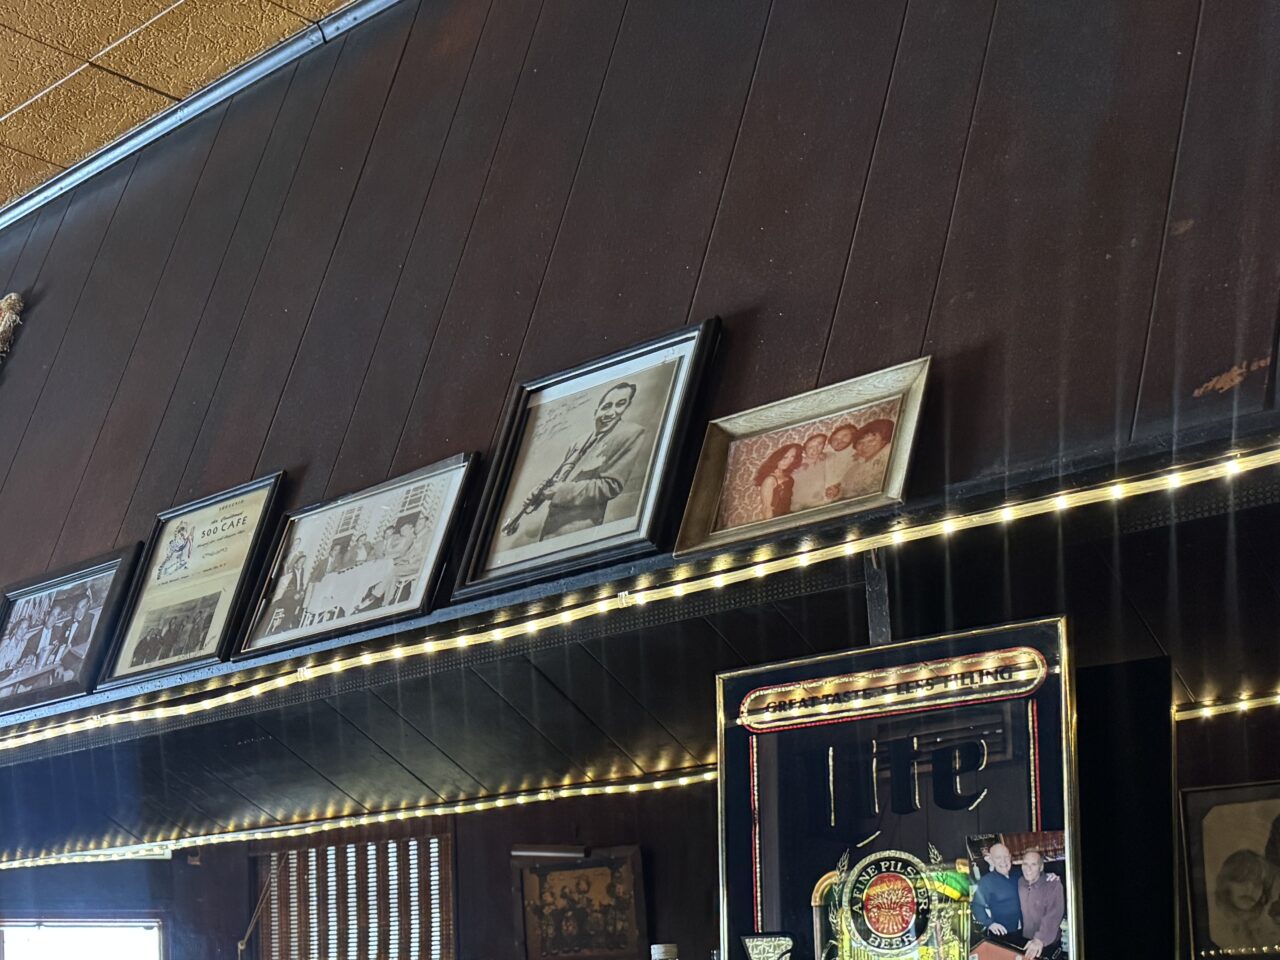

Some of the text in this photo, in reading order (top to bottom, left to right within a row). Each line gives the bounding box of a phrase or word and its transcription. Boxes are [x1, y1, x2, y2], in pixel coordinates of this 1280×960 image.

[201, 526, 218, 539] 500
[220, 516, 248, 532] CAFE
[852, 860, 929, 915] A FINE PILSER
[867, 932, 917, 949] BEER
